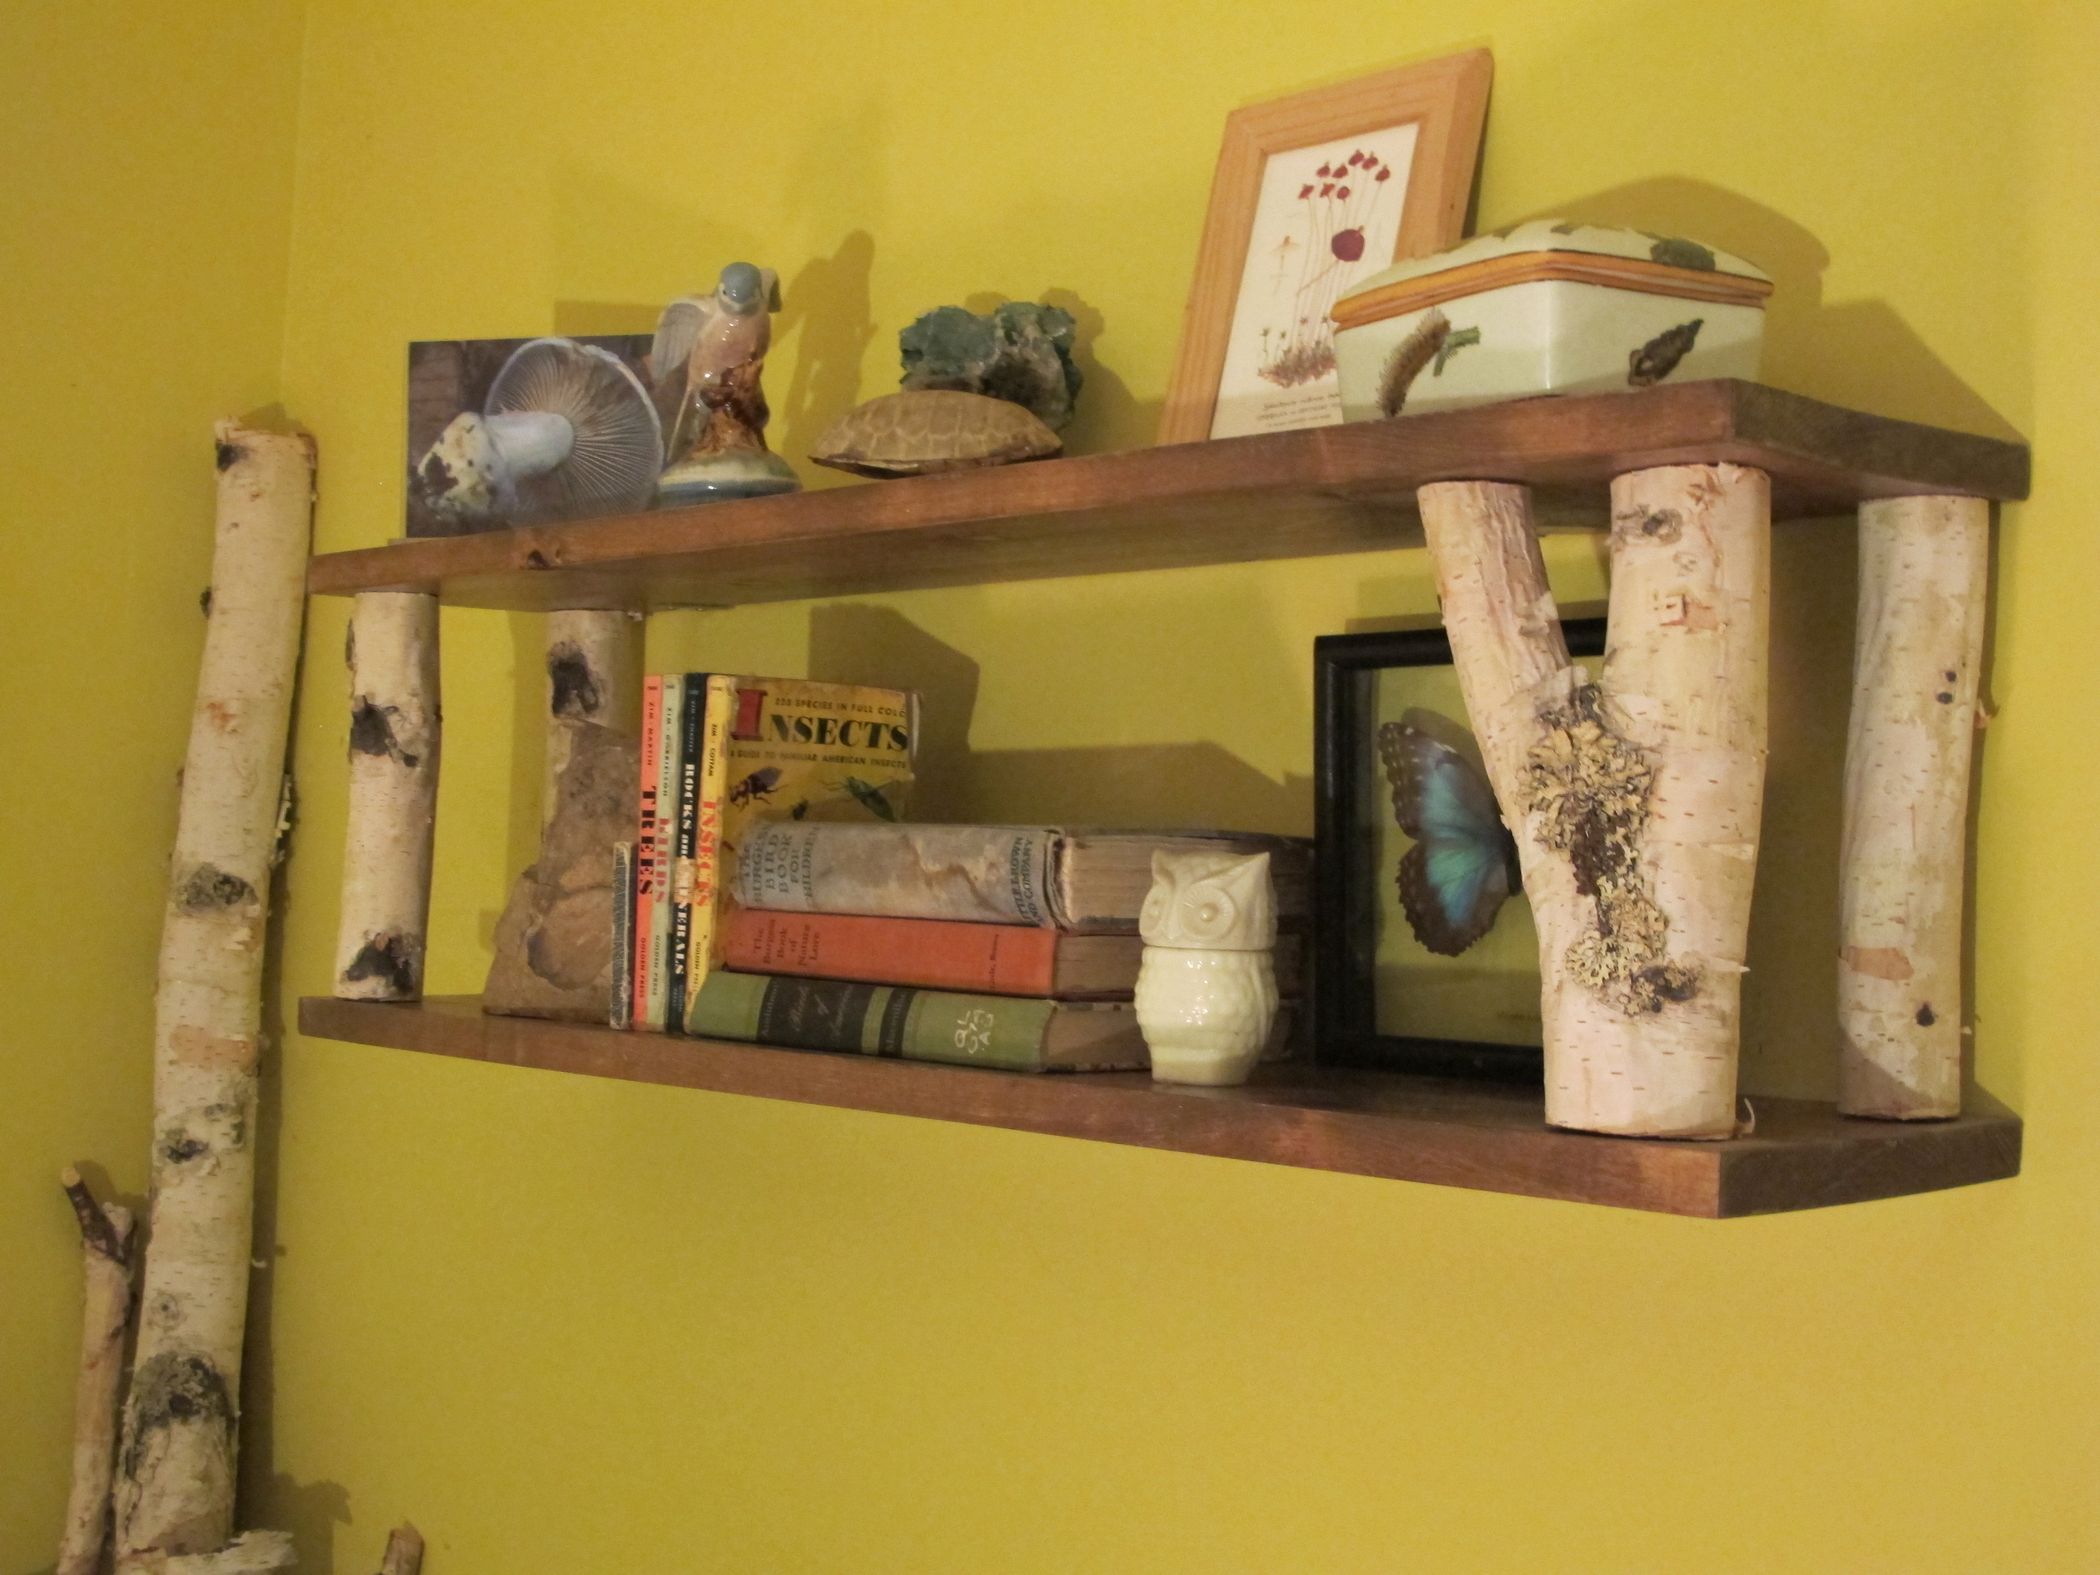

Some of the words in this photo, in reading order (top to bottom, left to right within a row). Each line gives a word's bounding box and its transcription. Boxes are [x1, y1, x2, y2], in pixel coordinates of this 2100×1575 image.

[796, 698, 833, 710] SPECIES
[836, 701, 848, 712] IN
[851, 703, 873, 714] FULL
[708, 747, 718, 777] COTTAM
[822, 754, 866, 766] AMERICAN
[870, 757, 907, 769] INSECTS
[682, 763, 695, 830] ROCKS
[640, 785, 656, 895] TREES
[655, 818, 671, 903] BIRDS
[695, 801, 717, 907] INSECTS
[764, 833, 779, 890] BIRD
[776, 833, 793, 894] BOOK
[1010, 836, 1023, 884] BROWN
[790, 848, 800, 884] FOR
[1020, 838, 1034, 900] COMPANY
[776, 928, 788, 959] Book
[797, 924, 811, 966] Nature
[954, 1010, 971, 1048] QL
